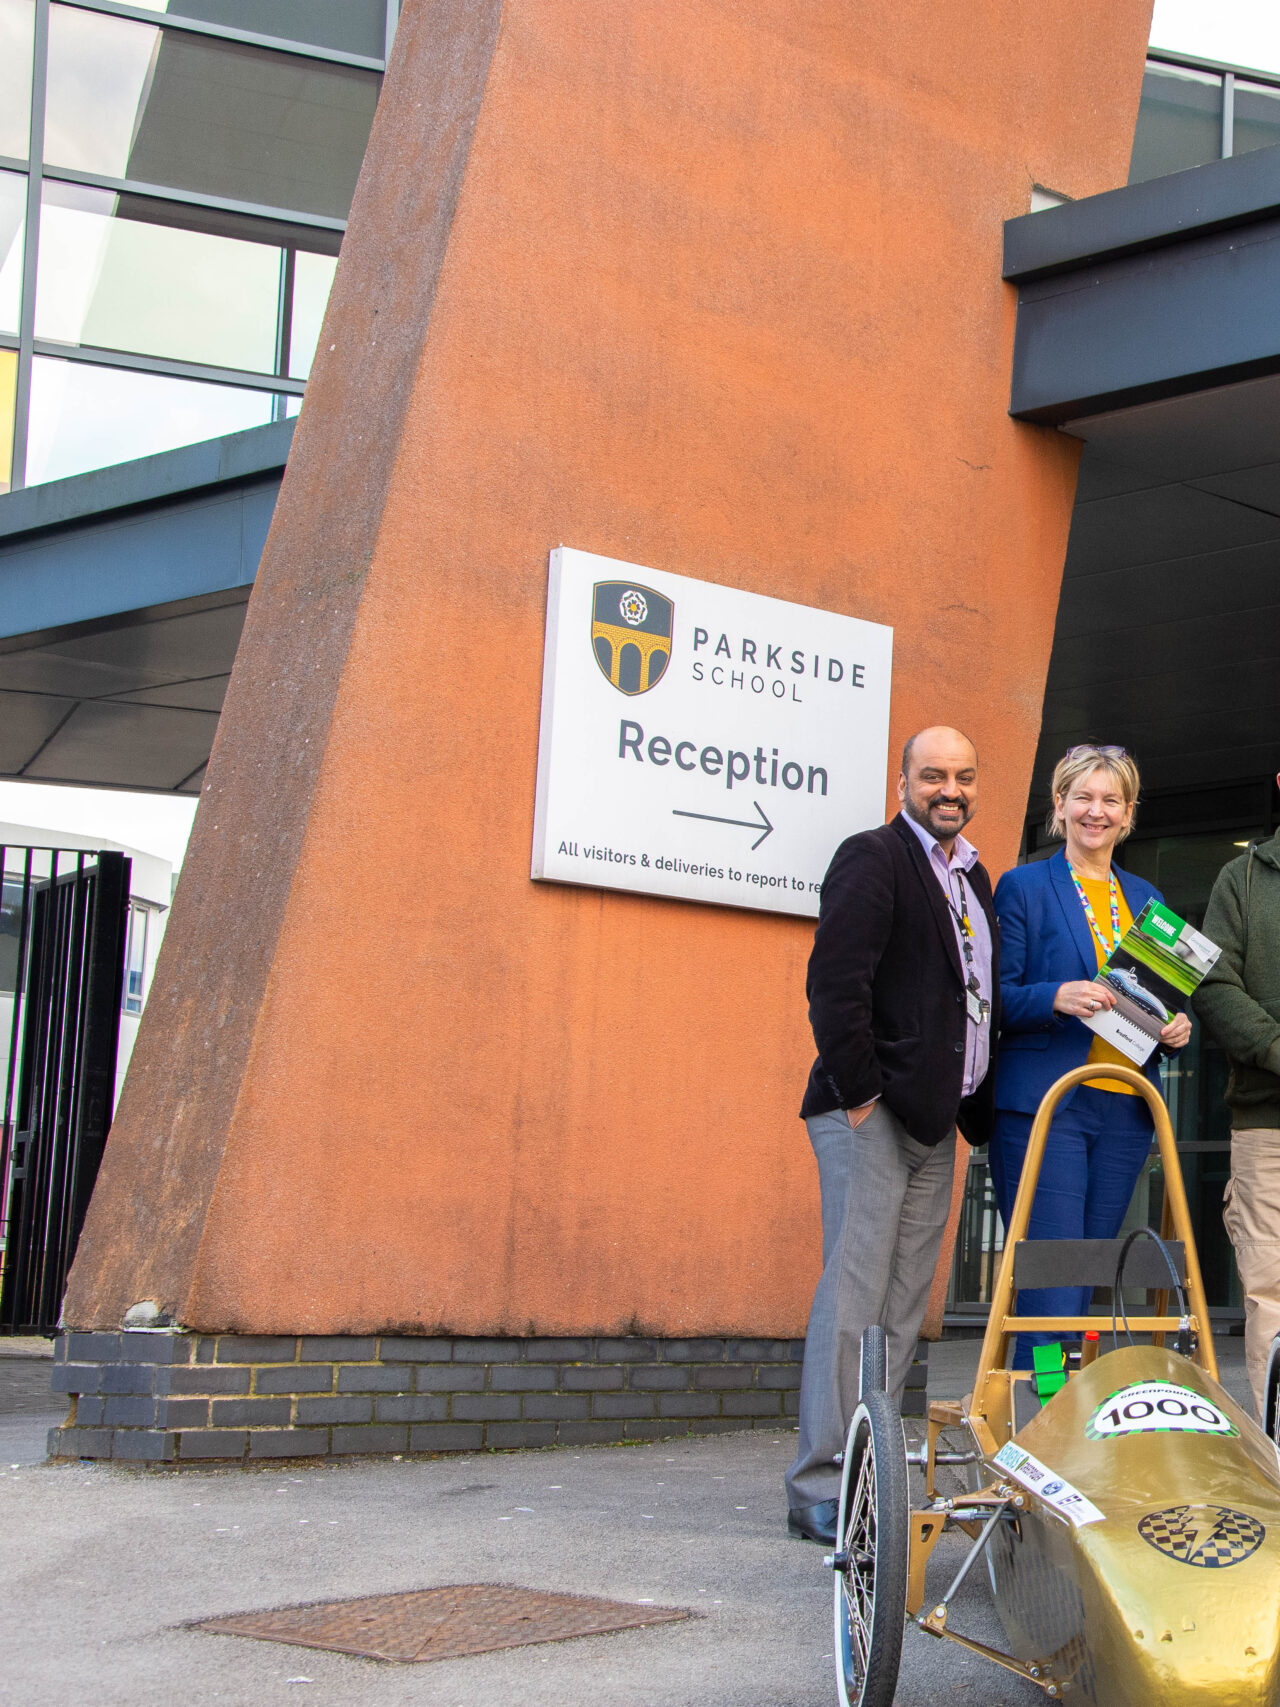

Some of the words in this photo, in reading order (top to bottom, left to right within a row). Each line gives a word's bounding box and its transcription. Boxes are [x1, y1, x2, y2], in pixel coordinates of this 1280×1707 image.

[694, 627, 866, 689] PARKSIDE
[692, 662, 802, 702] SCHOOL
[618, 719, 829, 796] Reception
[558, 840, 579, 858] All
[583, 844, 636, 866] visitors
[640, 853, 650, 868] &
[655, 856, 724, 879] deliveries
[728, 866, 742, 882] to
[745, 871, 788, 890] report
[791, 875, 805, 891] to
[808, 881, 821, 895] re
[1151, 914, 1177, 937] WELCOME
[1116, 1028, 1133, 1044] Bradford
[1120, 1388, 1197, 1400] GREENPOWER
[1102, 1399, 1220, 1426] 1000
